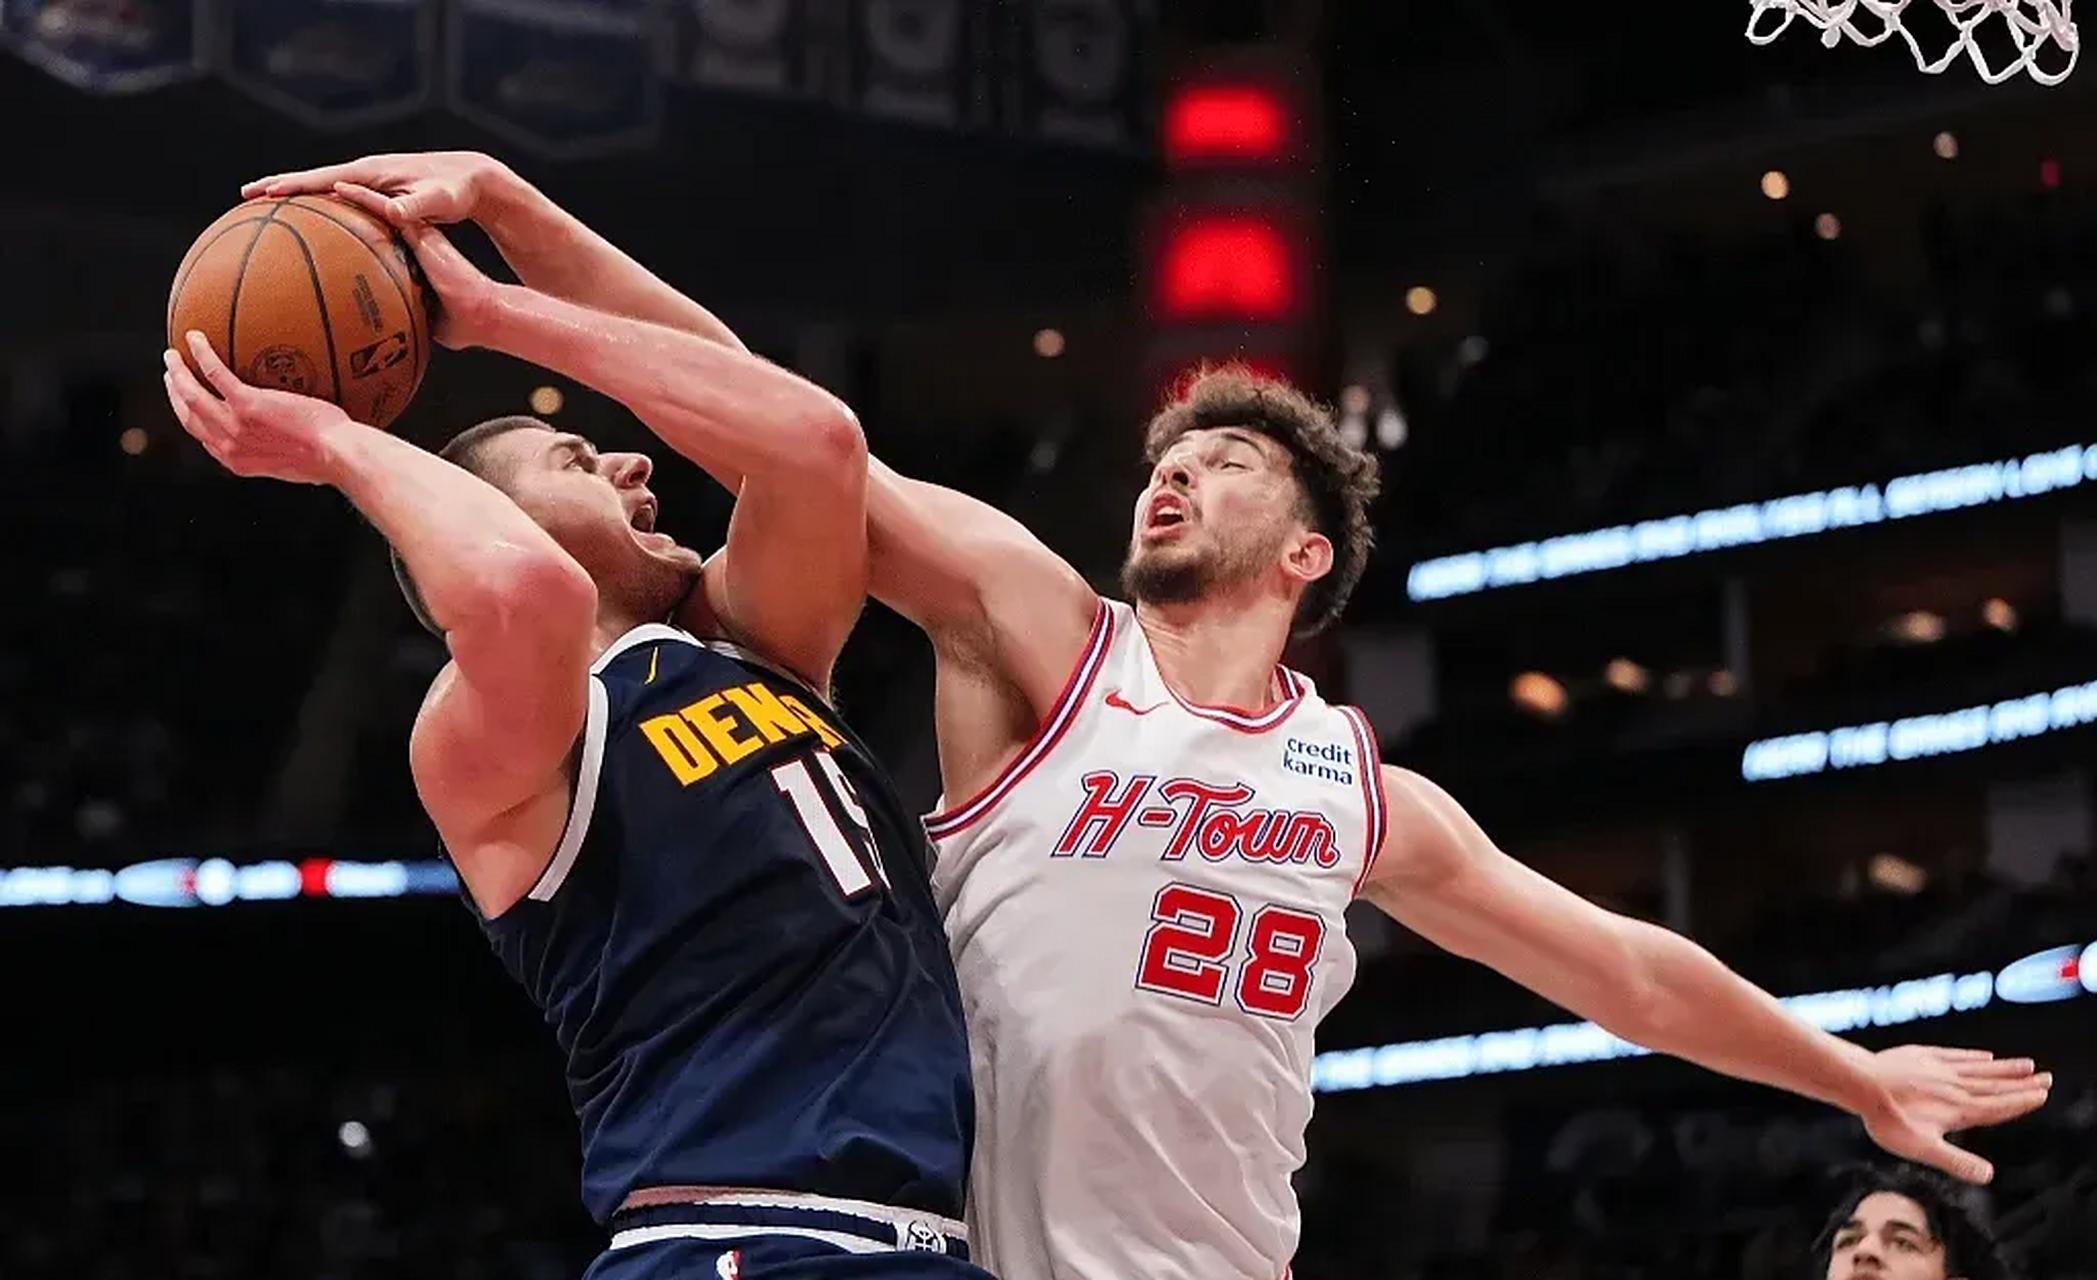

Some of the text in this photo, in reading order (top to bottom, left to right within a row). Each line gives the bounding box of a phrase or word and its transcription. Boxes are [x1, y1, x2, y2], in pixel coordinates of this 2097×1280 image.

[1283, 749, 1353, 785] karma
[1287, 738, 1353, 766] credit
[1050, 770, 1341, 869] H-Town
[1135, 881, 1327, 1022] 28
